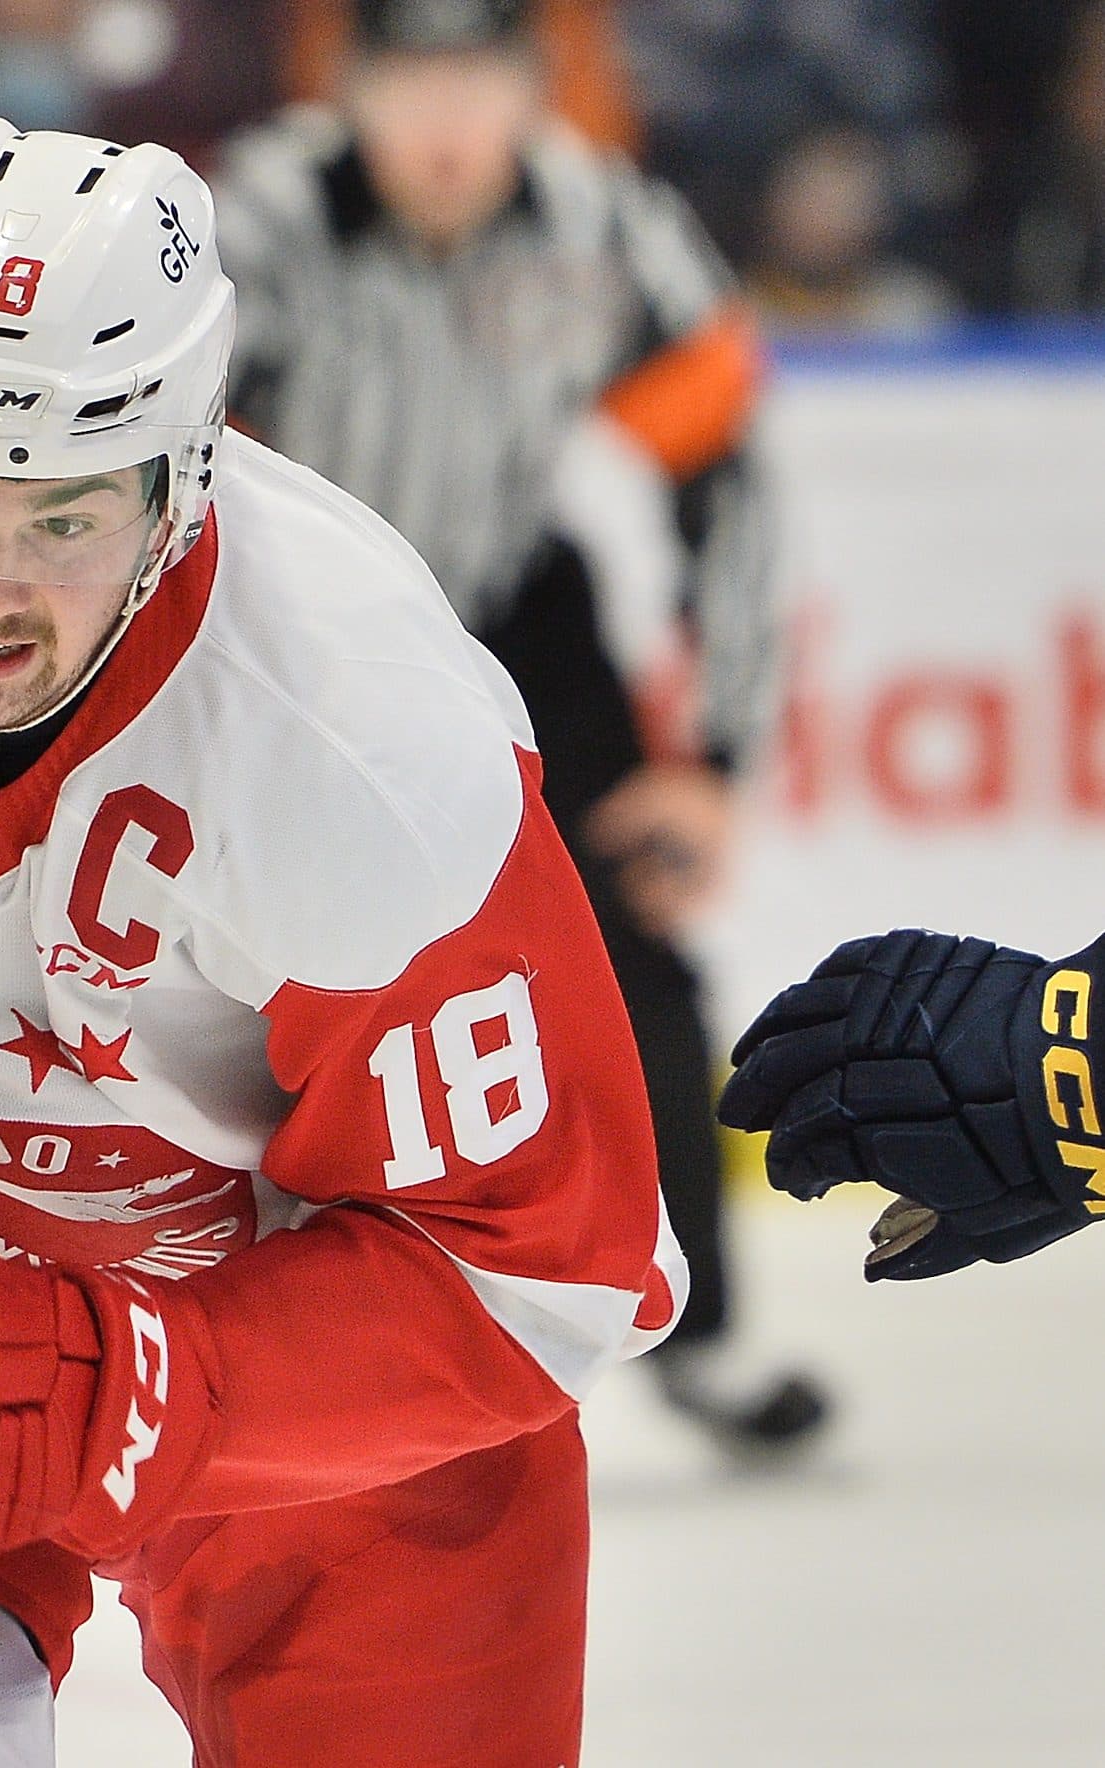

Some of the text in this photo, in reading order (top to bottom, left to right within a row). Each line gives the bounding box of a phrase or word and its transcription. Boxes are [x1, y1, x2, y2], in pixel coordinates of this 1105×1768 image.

[159, 203, 200, 283] GFL
[37, 943, 150, 989] CM
[67, 784, 194, 971] C
[368, 972, 549, 1190] 18
[101, 1270, 169, 1514] CM
